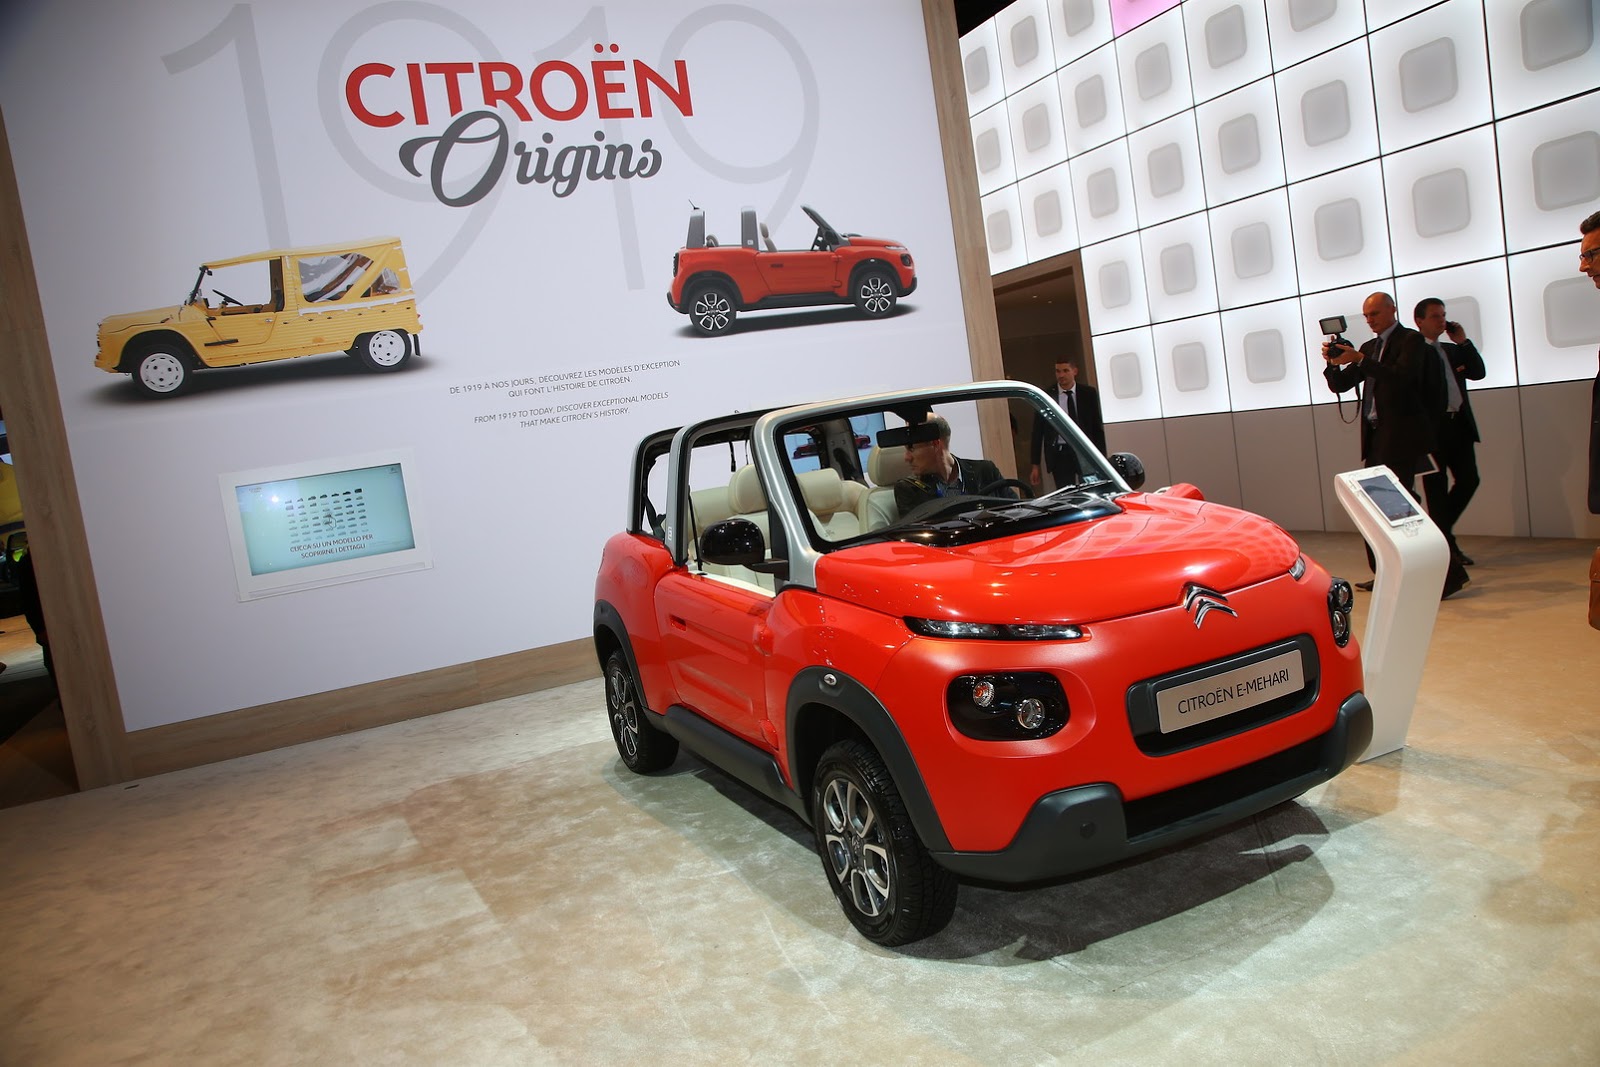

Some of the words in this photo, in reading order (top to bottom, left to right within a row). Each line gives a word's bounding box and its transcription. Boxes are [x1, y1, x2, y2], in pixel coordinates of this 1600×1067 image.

[345, 43, 694, 128] CITROËN
[398, 109, 663, 208] Origins
[449, 386, 461, 395] DE
[463, 383, 482, 393] 1919
[492, 380, 510, 389] NOS
[584, 369, 597, 378] LES
[634, 360, 681, 372] D'EXCEPTION
[508, 389, 523, 398] QUI
[524, 386, 545, 396] FONT
[546, 381, 586, 394] L'HISTOIRE
[587, 380, 598, 388] DE
[474, 414, 496, 424] FROM
[498, 411, 517, 420] 1919
[518, 410, 529, 418] TO
[556, 401, 592, 413] DISCOVER
[593, 396, 639, 408] EXCEPTIONAL
[640, 391, 669, 401] MODELS
[520, 419, 539, 428] THAT
[539, 417, 561, 426] MAKE
[599, 407, 630, 417] HISTORY.
[290, 544, 312, 553] CLICCA
[333, 536, 361, 546] MODELLO
[362, 533, 374, 541] PER
[300, 548, 334, 559] SCOPRIRNE
[338, 543, 366, 552] DETTAGLI
[1178, 686, 1234, 714] CITROËN
[1236, 668, 1290, 697] E-MEHARI
